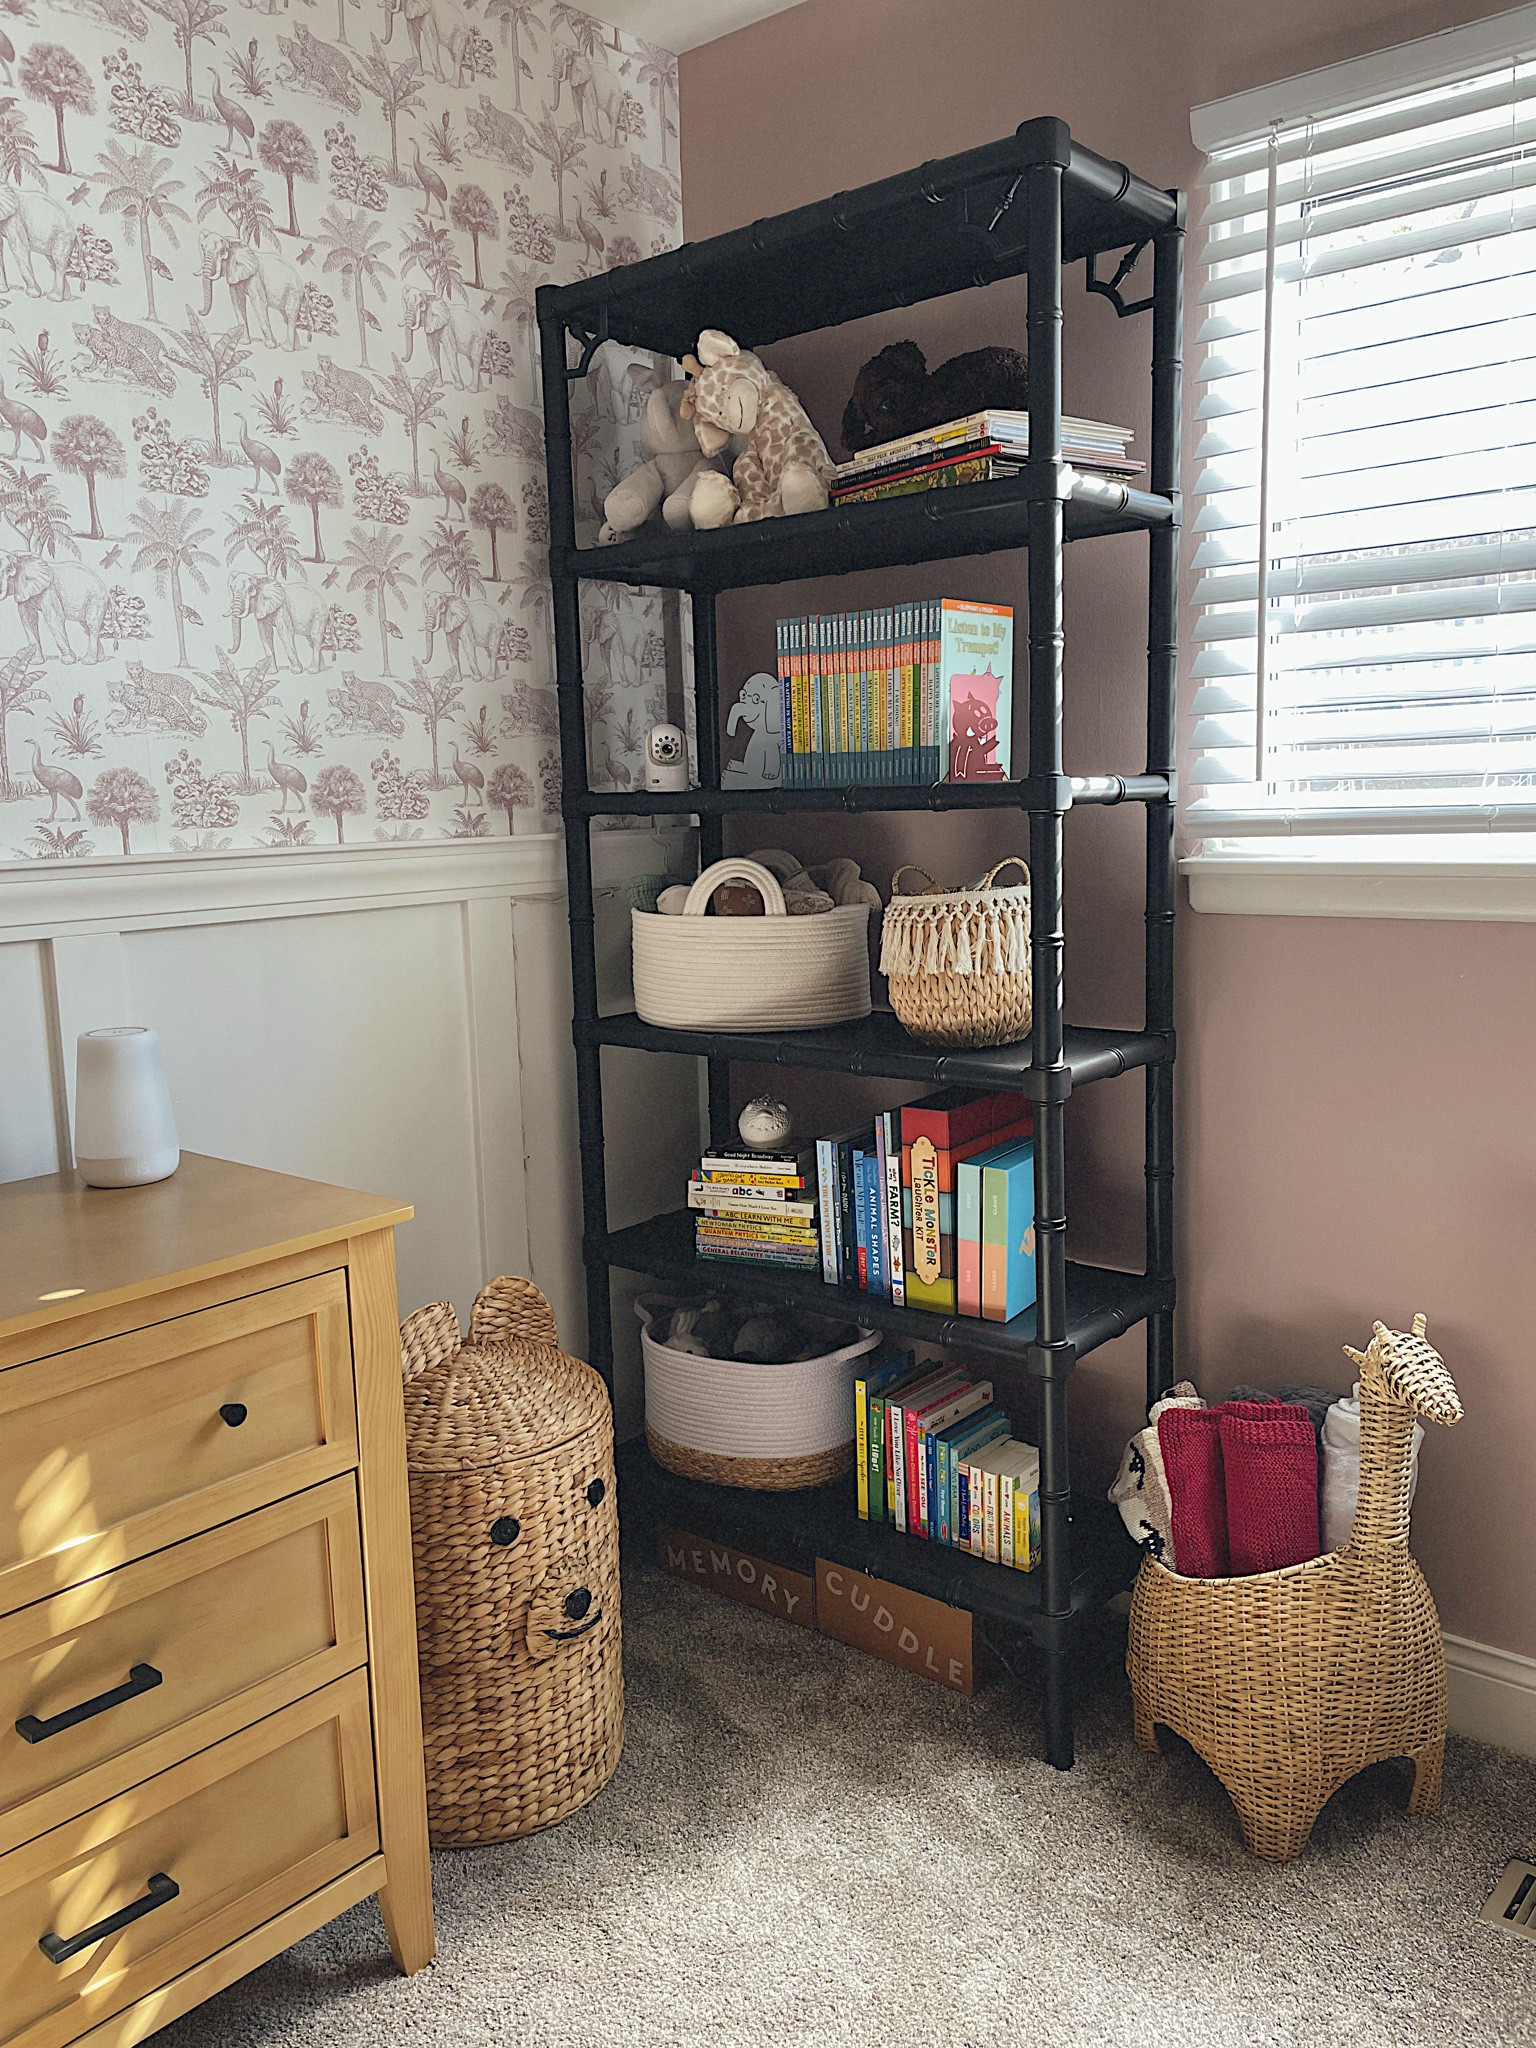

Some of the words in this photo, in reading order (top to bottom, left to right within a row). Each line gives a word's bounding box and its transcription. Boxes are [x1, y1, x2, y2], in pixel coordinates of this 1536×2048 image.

[948, 618, 978, 635] Listen
[981, 622, 990, 636] to
[992, 623, 1006, 641] My
[955, 637, 999, 657] Trumpet!
[751, 1152, 774, 1160] Broadway
[854, 1157, 864, 1171] Me
[732, 1187, 752, 1196] abc
[855, 1189, 867, 1203] My
[869, 1187, 878, 1229] ANIMAL
[889, 1186, 899, 1226] FARM?
[701, 1220, 736, 1229] NEWTONIAN
[741, 1212, 762, 1221] LEARN
[763, 1214, 782, 1223] WITH
[704, 1228, 733, 1236] QUANTUM
[735, 1230, 758, 1239] PHYSICS
[702, 1247, 729, 1255] GENERAL
[730, 1250, 763, 1258] RELATIVITY
[871, 1234, 880, 1275] SHAPES
[857, 1460, 867, 1483] Spider
[895, 1467, 901, 1476] No
[986, 1505, 994, 1522] FIRST
[666, 1545, 800, 1615] MEMORY
[825, 1571, 964, 1686] CUDDLE
